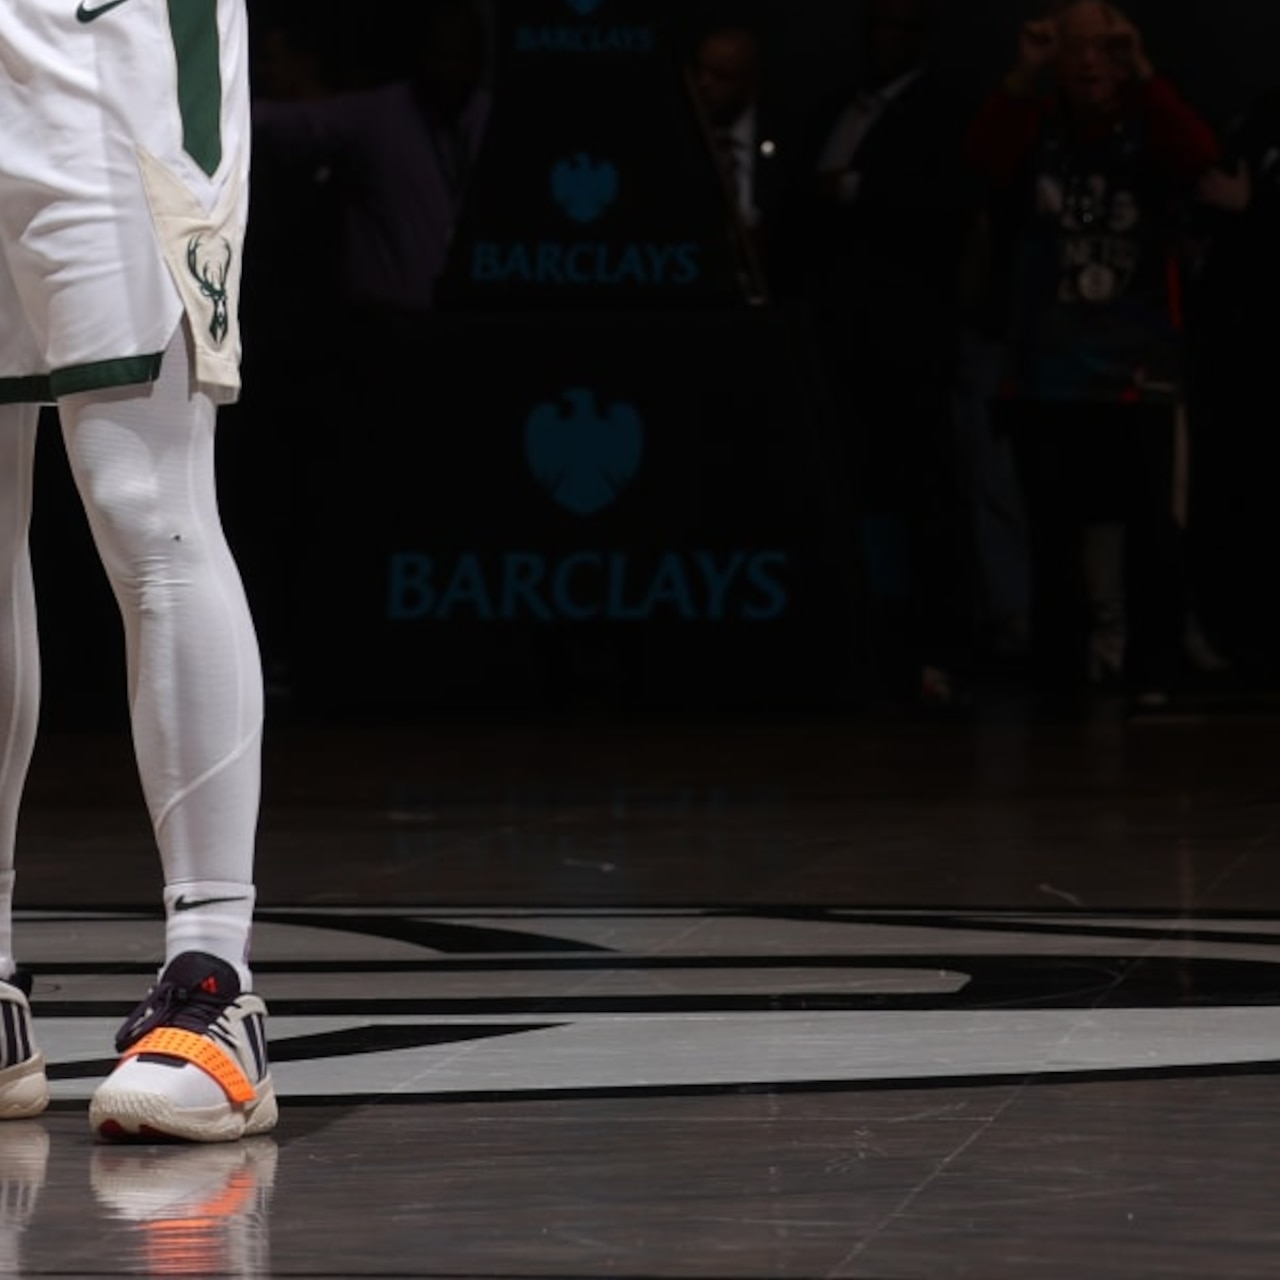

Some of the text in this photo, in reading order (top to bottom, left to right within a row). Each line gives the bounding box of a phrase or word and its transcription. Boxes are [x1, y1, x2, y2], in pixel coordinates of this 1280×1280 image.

[515, 23, 657, 53] BARCLAYS
[471, 238, 702, 286] BARCLAYS
[386, 549, 790, 621] BARCLAYS
